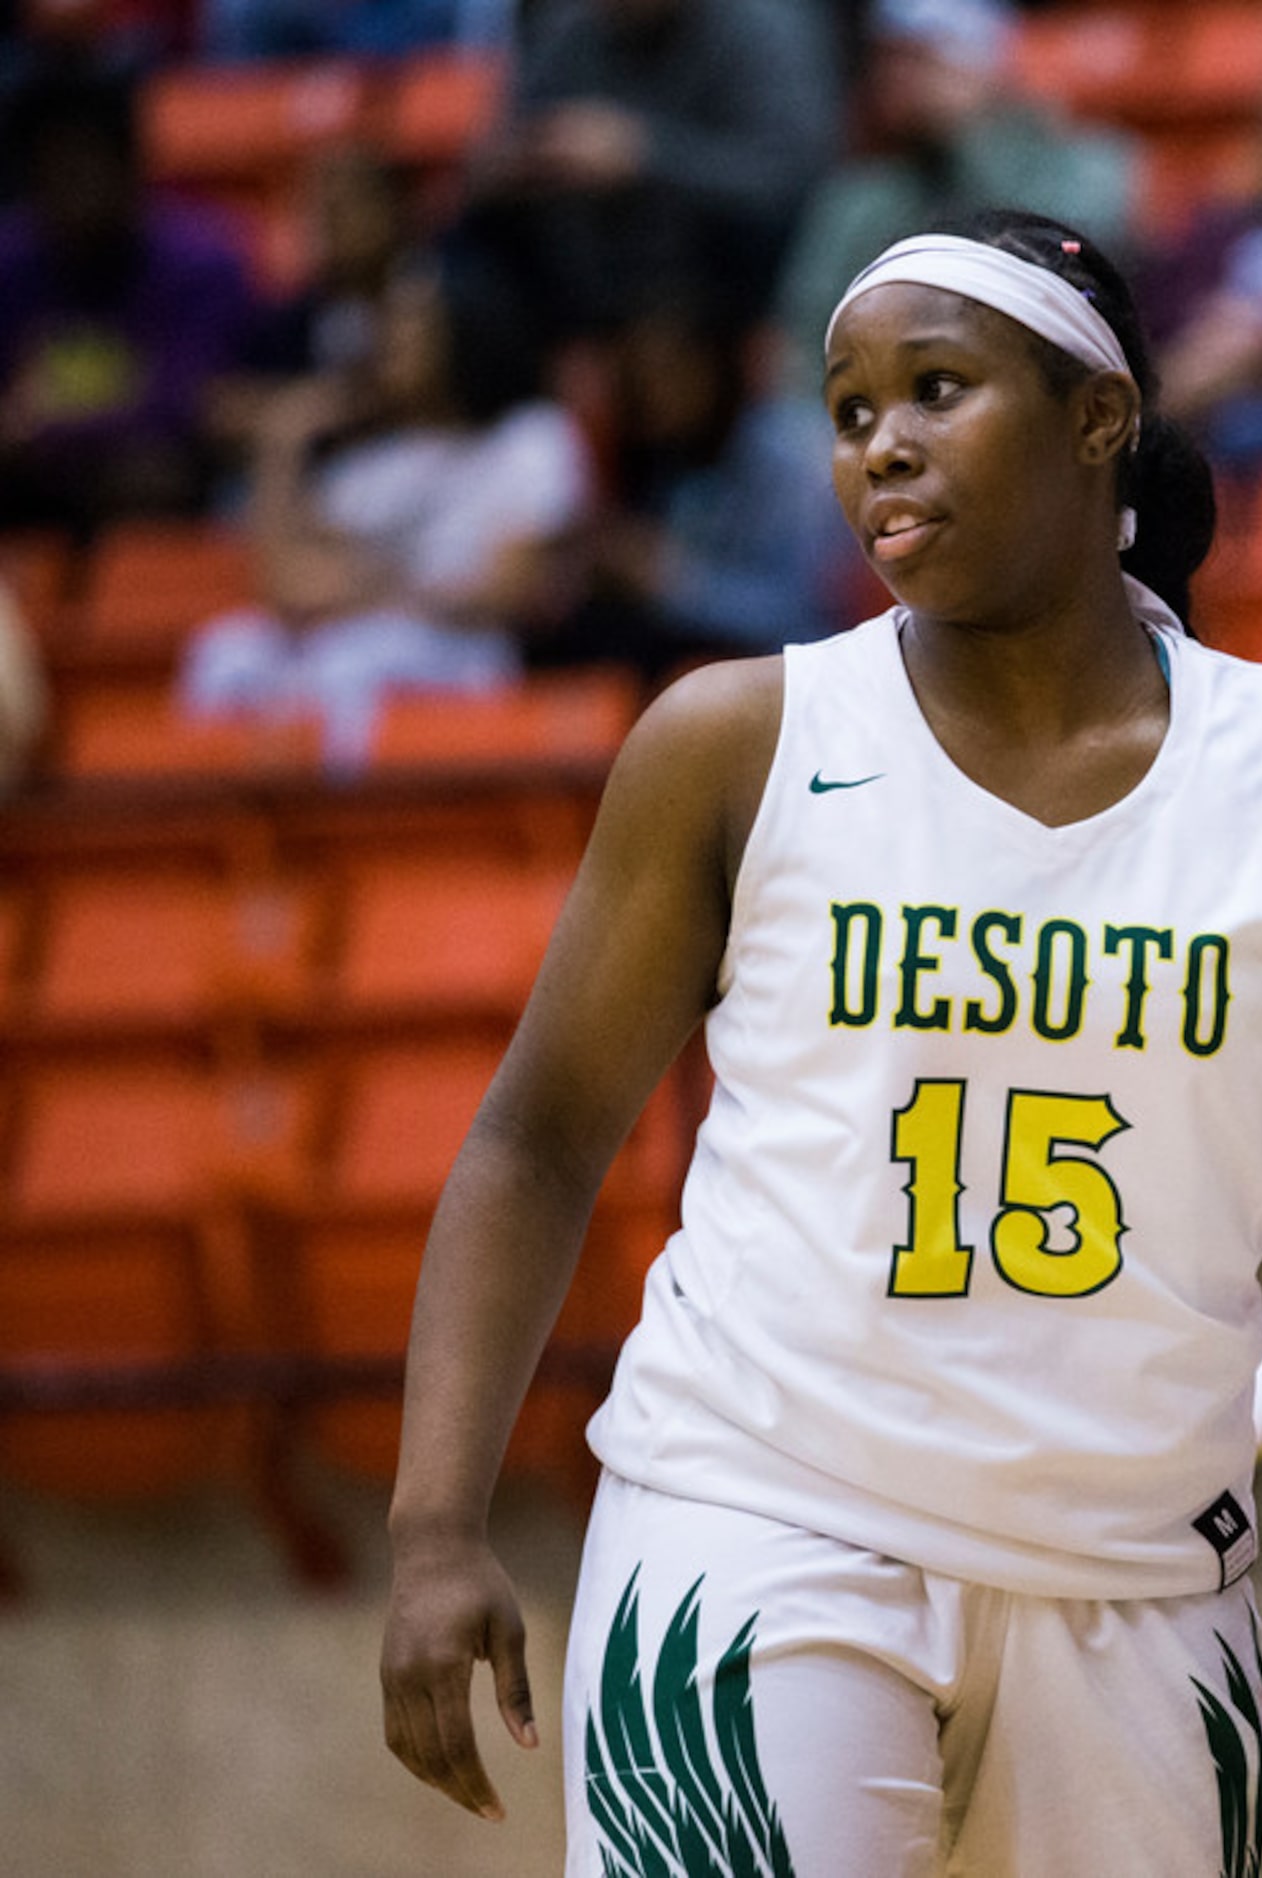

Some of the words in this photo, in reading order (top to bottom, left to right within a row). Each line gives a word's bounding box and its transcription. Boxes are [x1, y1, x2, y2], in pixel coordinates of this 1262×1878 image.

[827, 899, 1234, 1059] DESOTO
[886, 1077, 1134, 1298] 15
[1213, 1508, 1239, 1538] M
